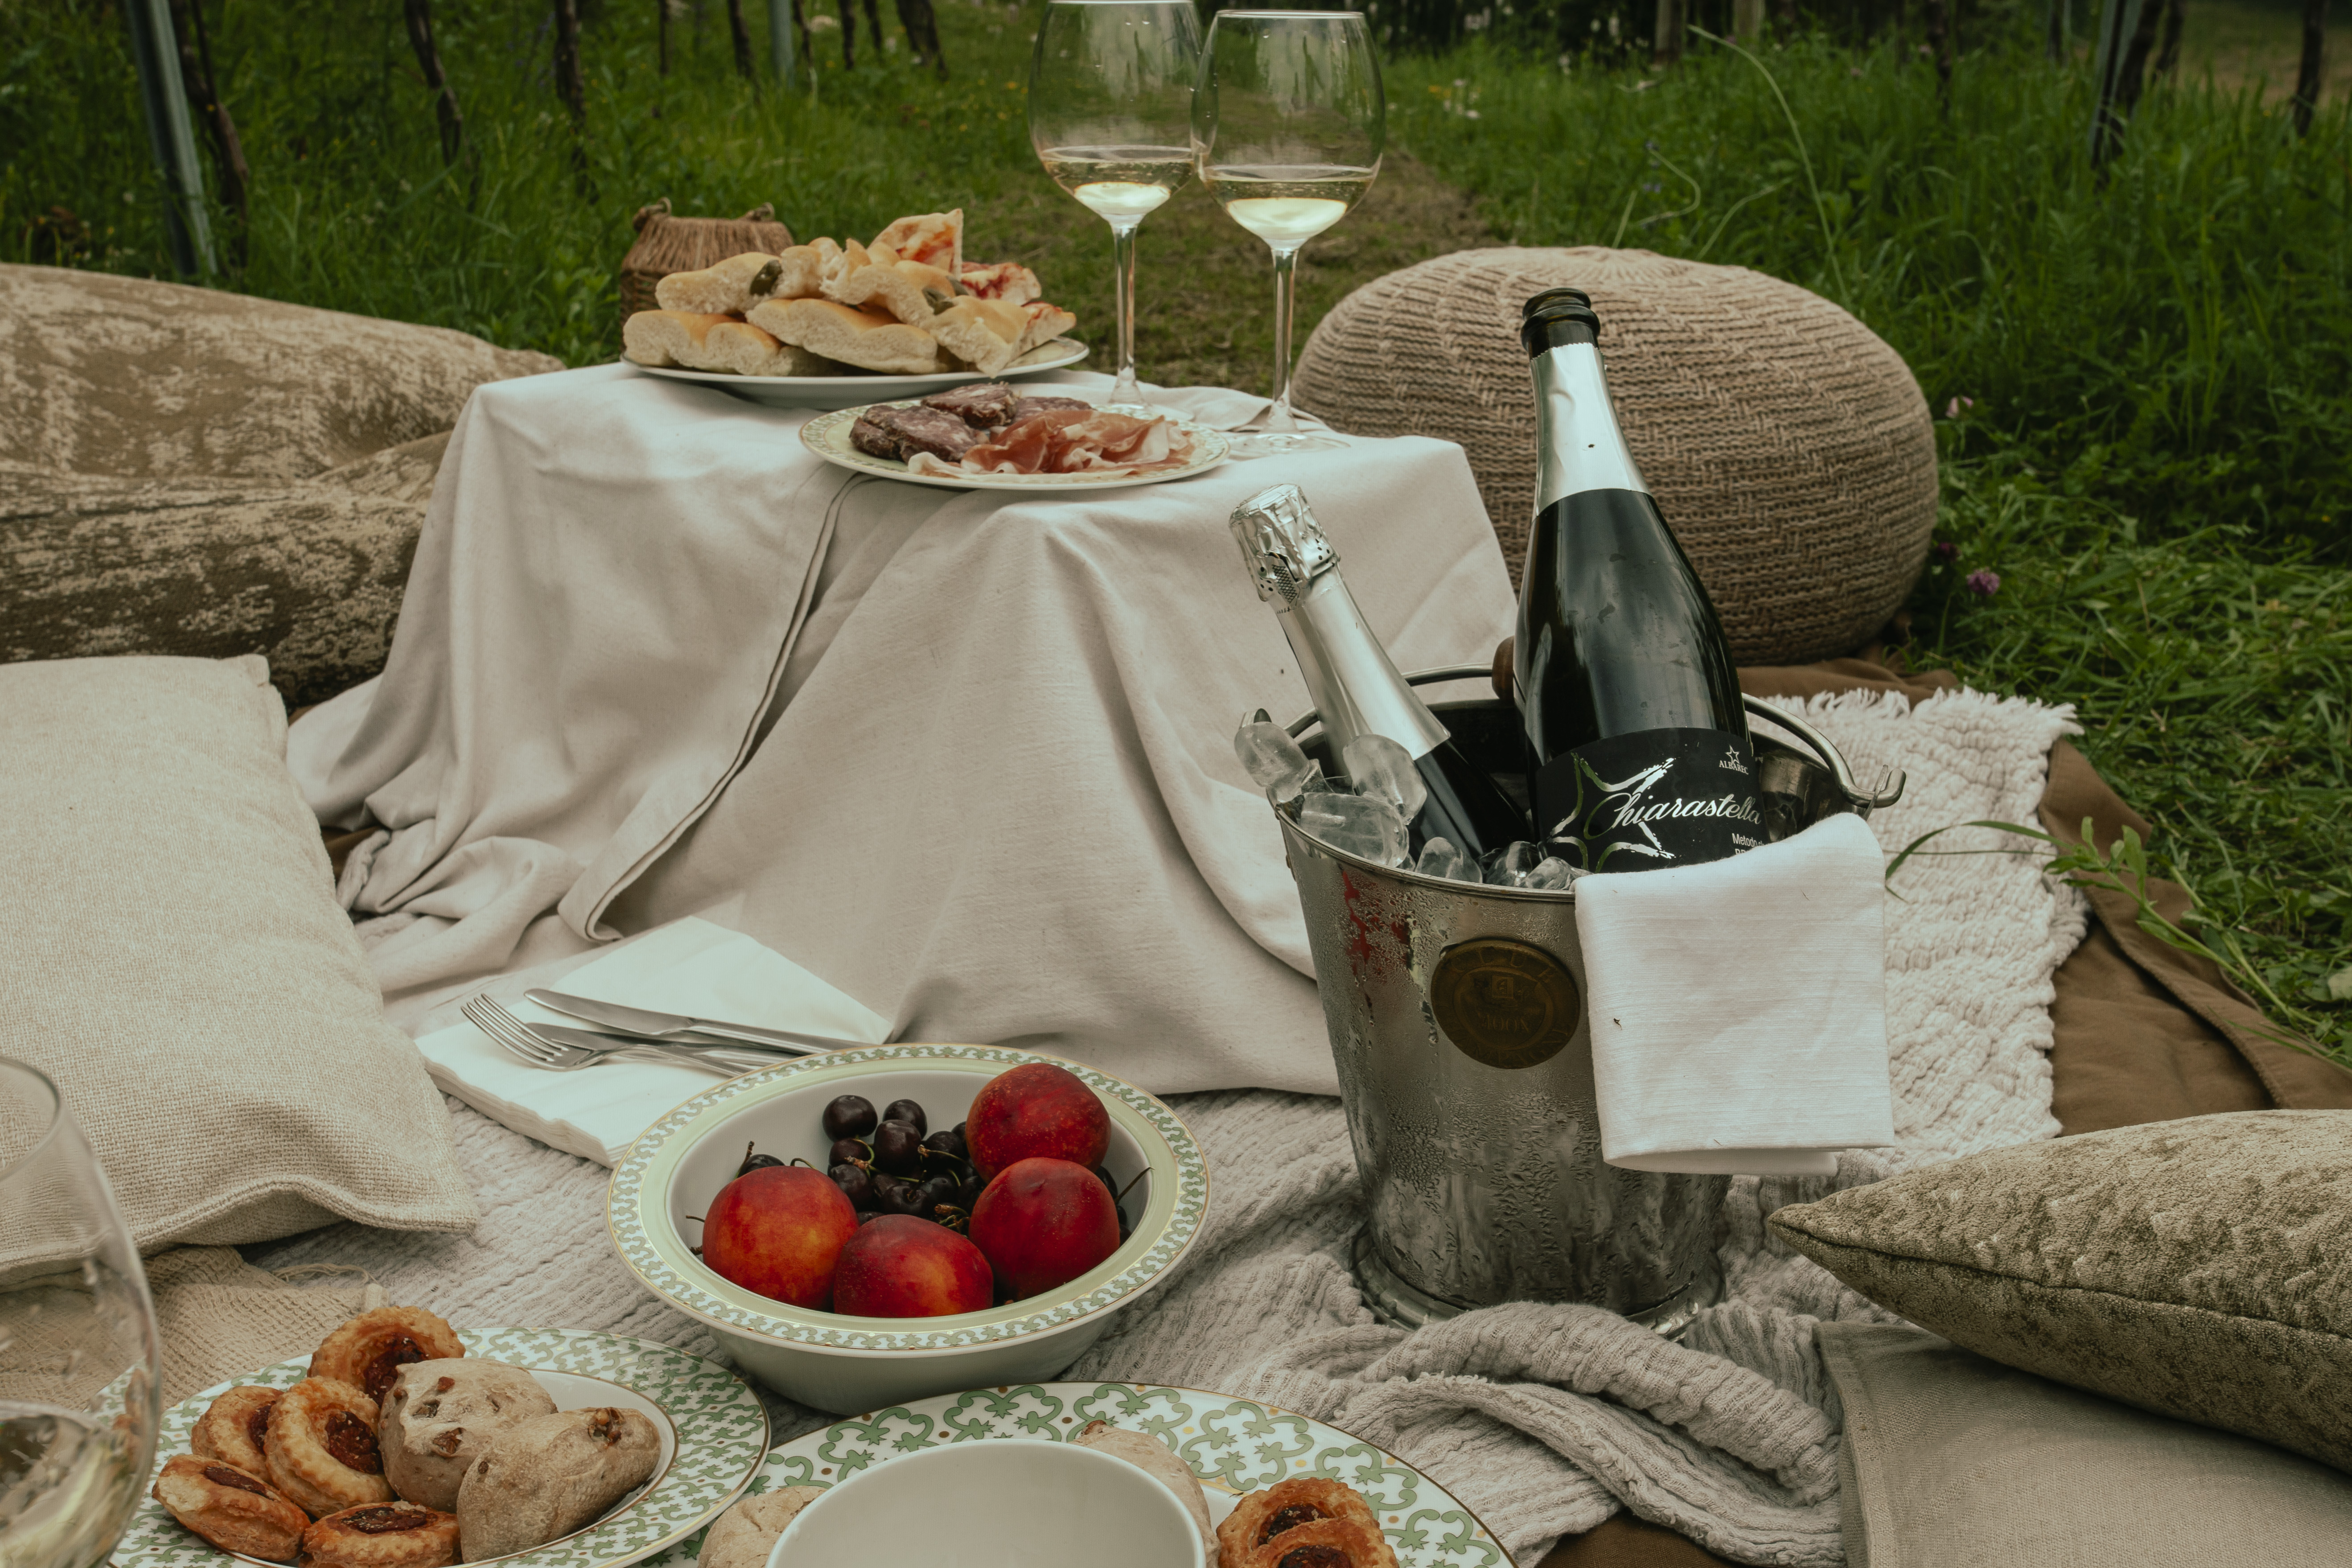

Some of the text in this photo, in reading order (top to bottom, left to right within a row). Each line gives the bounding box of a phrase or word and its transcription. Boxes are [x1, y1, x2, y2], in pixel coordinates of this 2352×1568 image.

[1719, 760, 1749, 775] ALBAREC
[1583, 792, 1762, 840] Chiarastella
[1732, 833, 1758, 847] Metodo
